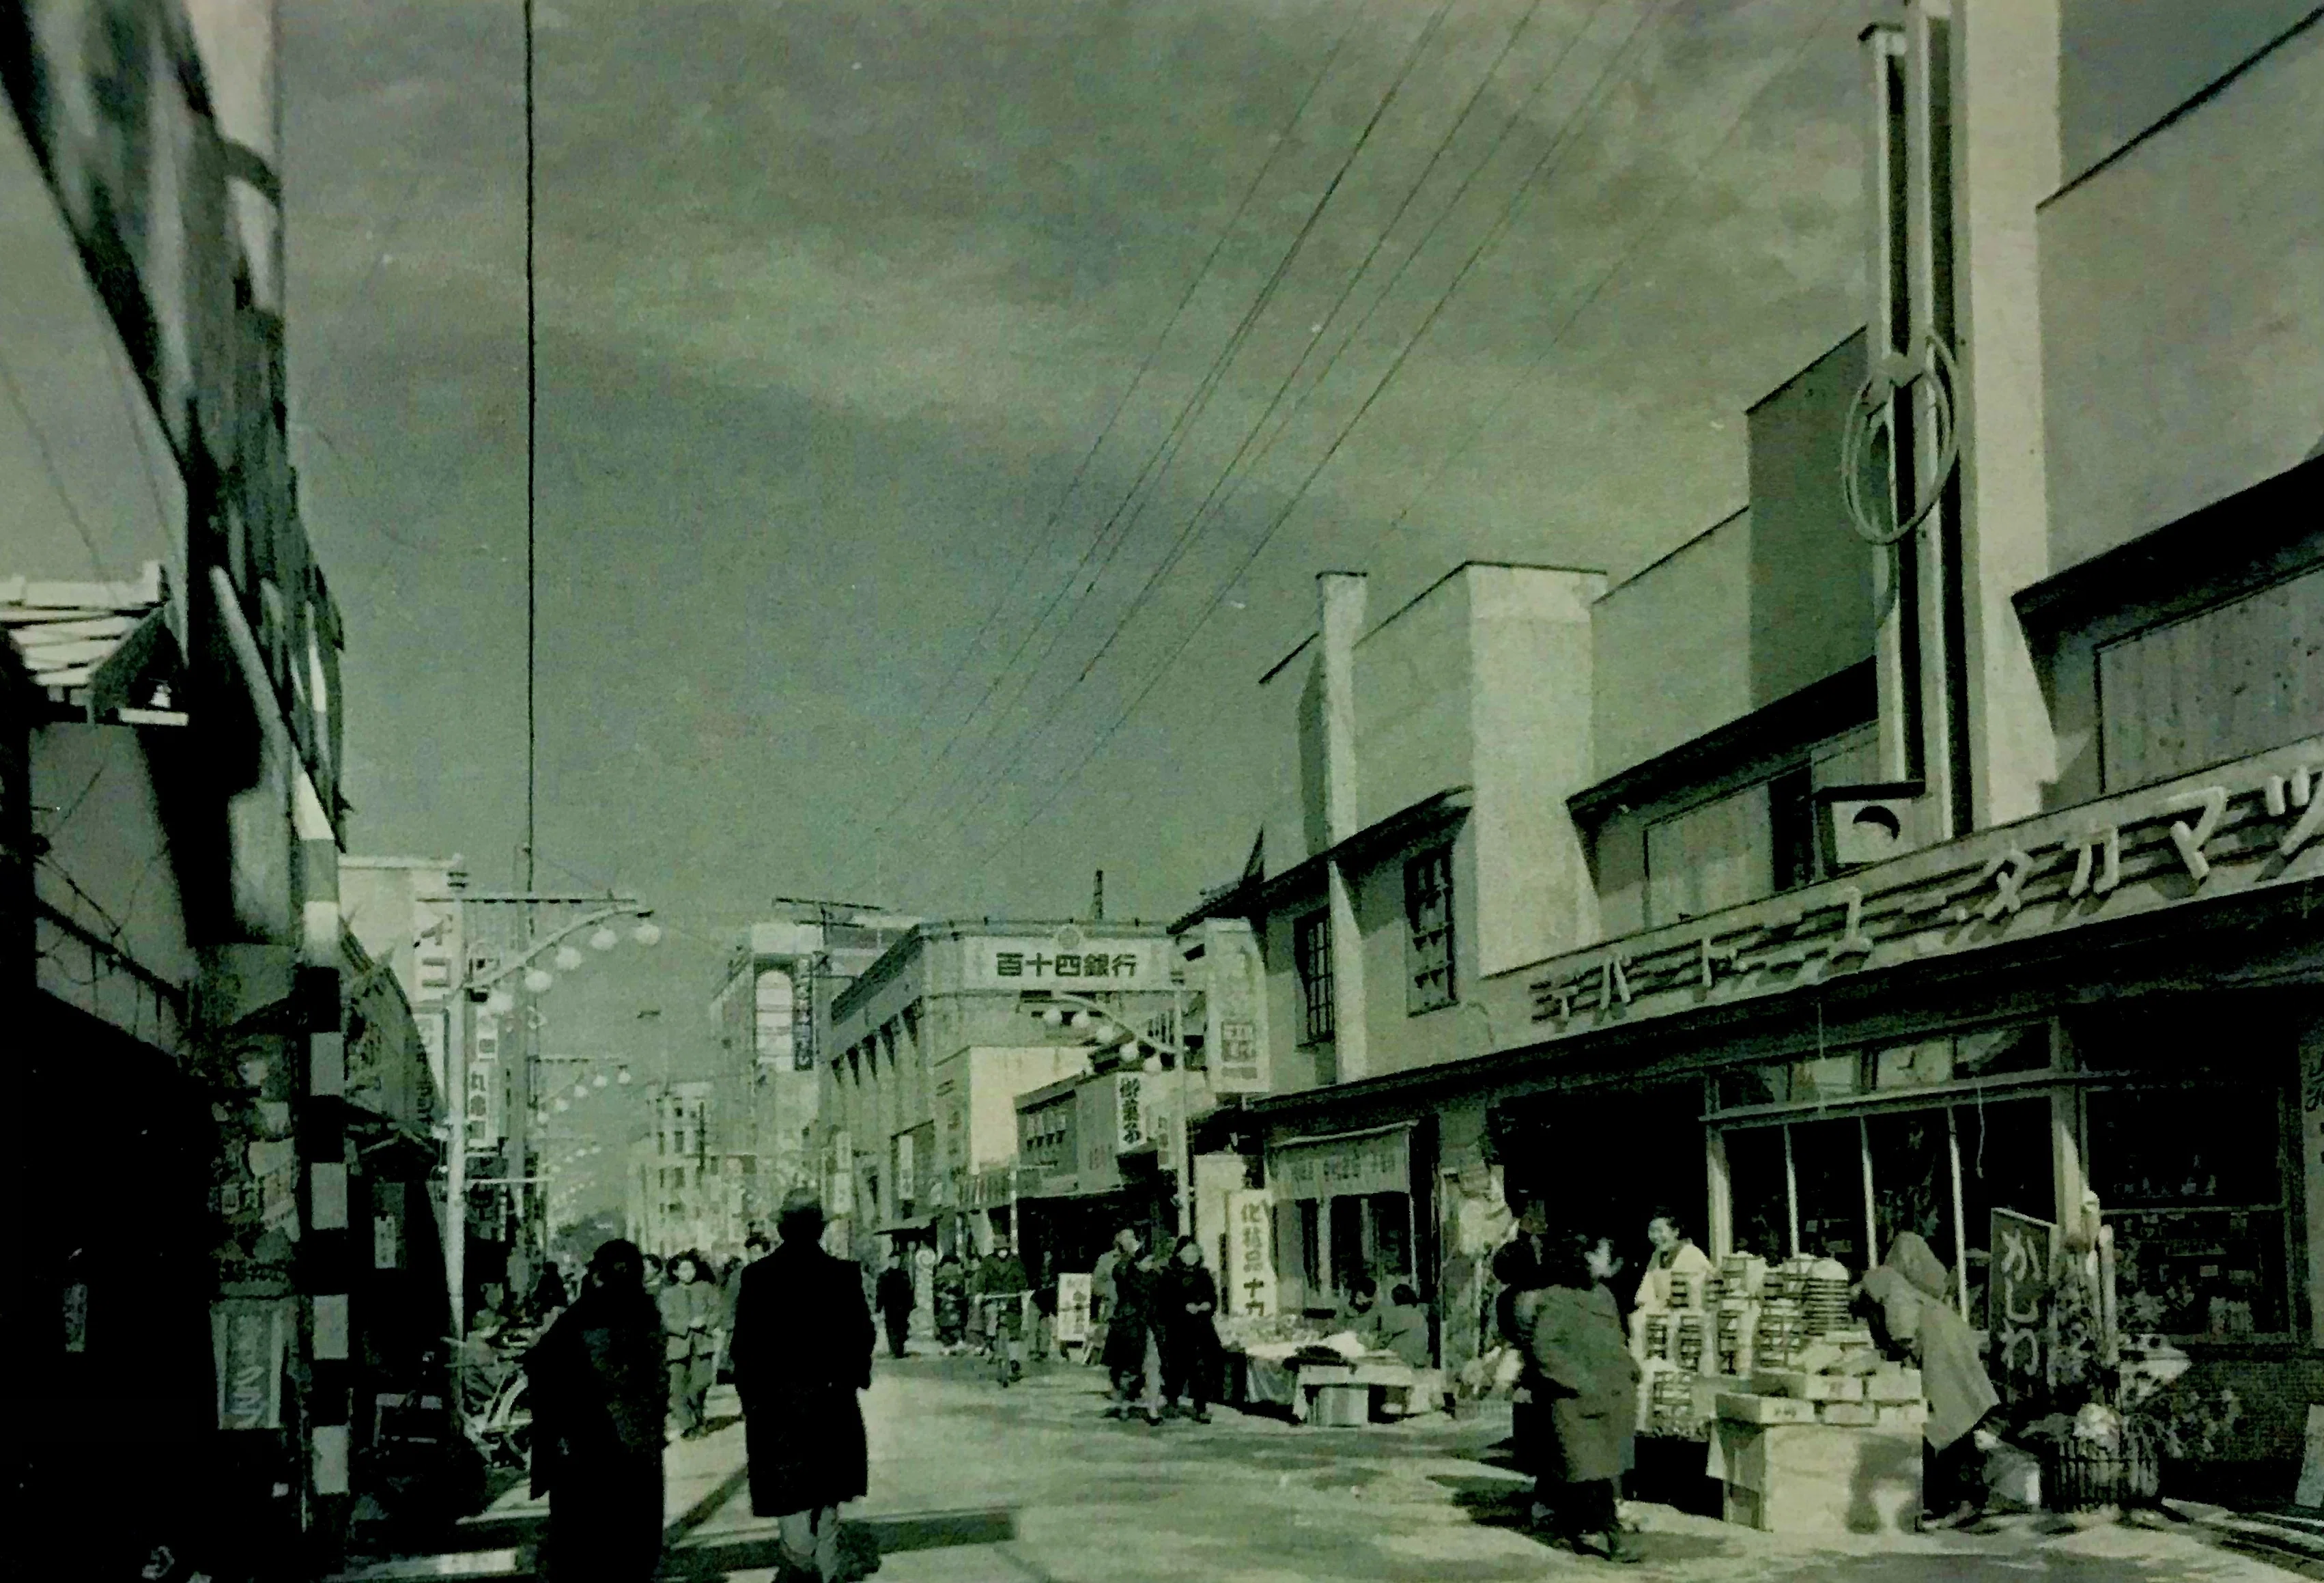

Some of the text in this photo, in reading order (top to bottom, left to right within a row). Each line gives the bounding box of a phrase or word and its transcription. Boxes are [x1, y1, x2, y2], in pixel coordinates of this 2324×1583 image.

[995, 951, 1137, 977] 百十四銀行
[1996, 1227, 2043, 1378] かしわ
